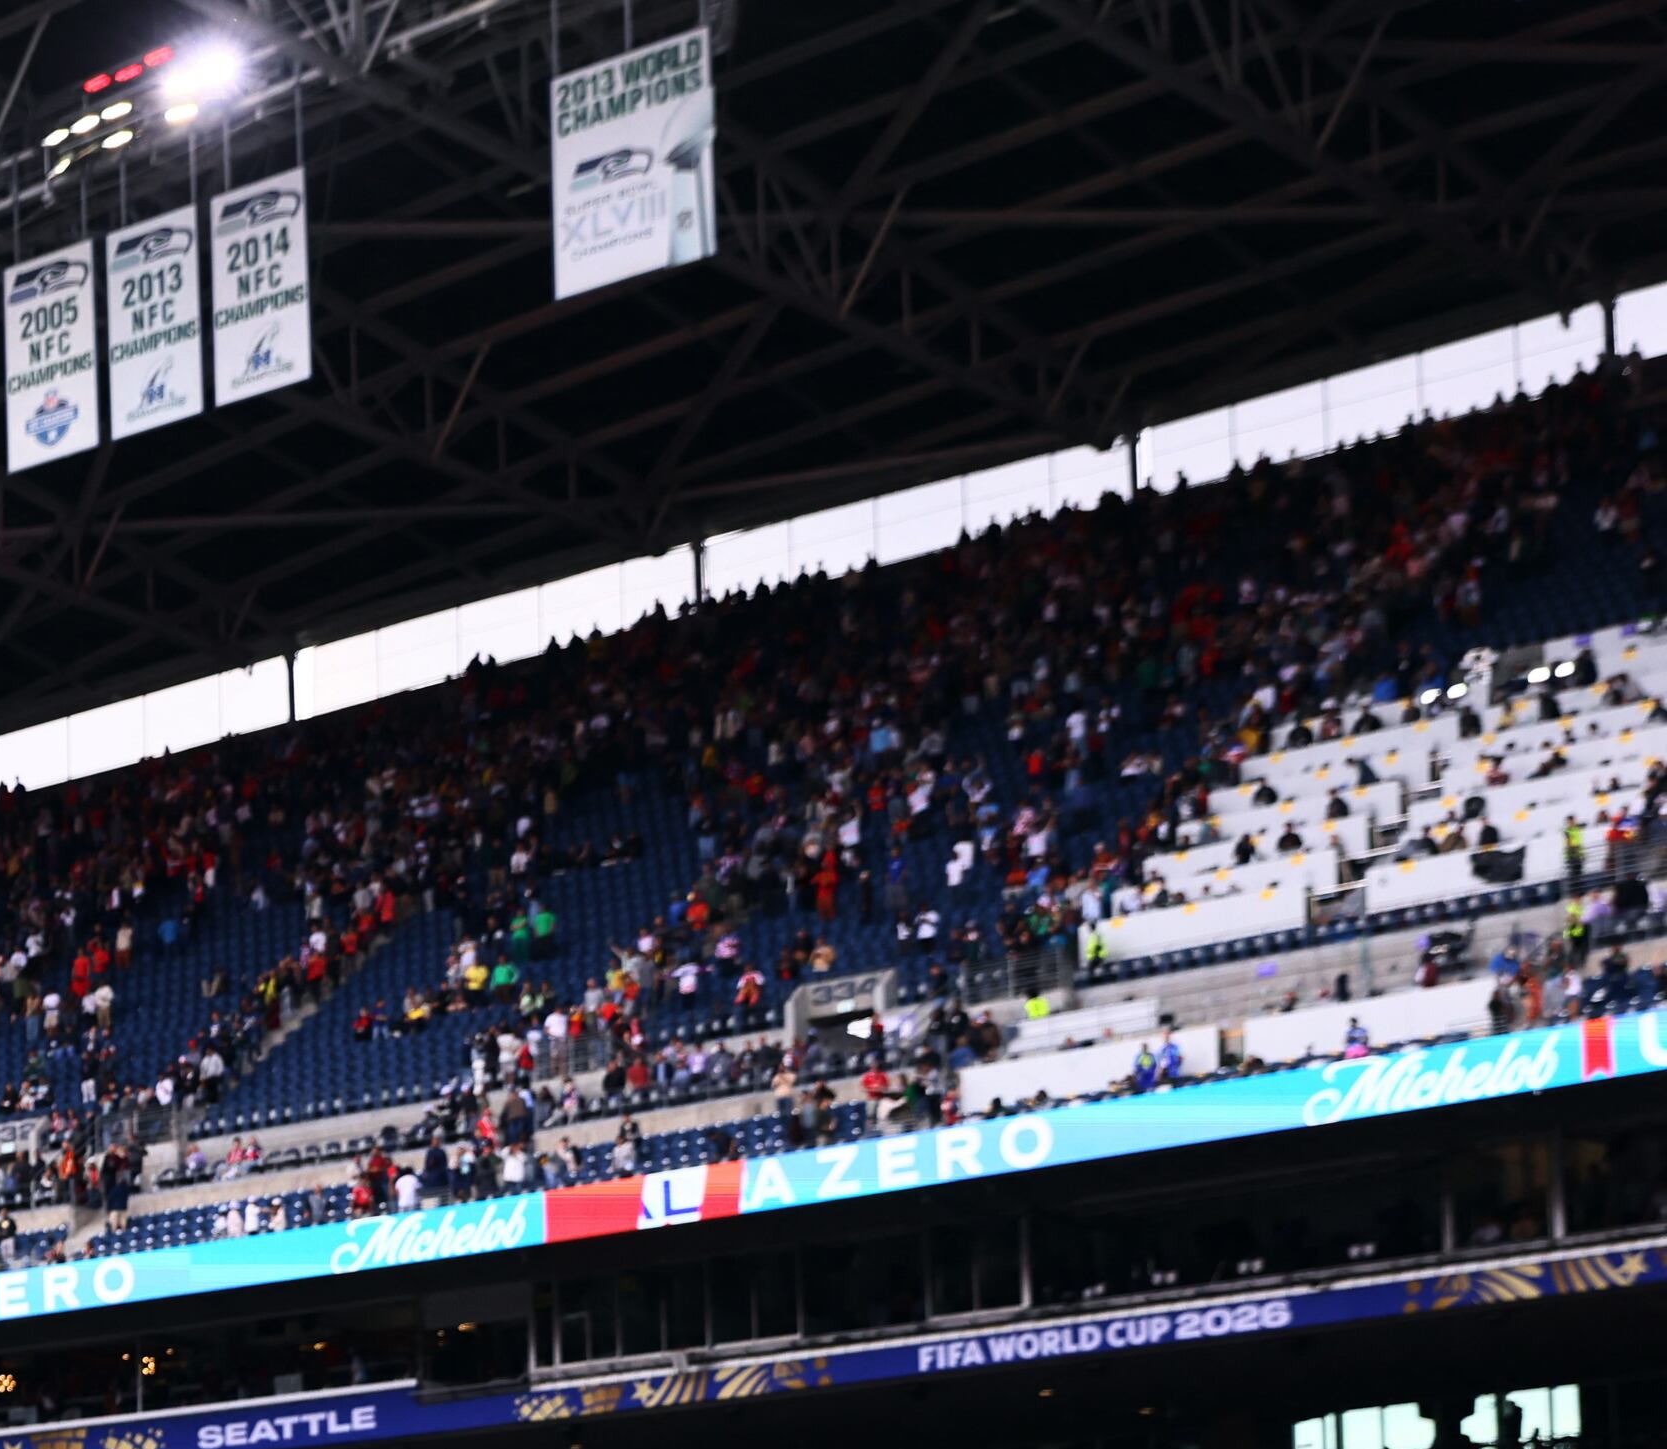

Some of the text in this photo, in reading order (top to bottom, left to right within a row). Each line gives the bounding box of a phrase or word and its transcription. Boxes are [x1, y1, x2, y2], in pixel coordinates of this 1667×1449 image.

[557, 37, 702, 111] 2013 WORLD
[558, 66, 702, 138] CHAMPIONS
[227, 226, 290, 273] 2014
[122, 263, 182, 309] 2013
[237, 263, 282, 298] NFC
[20, 295, 79, 341] 2005
[132, 300, 174, 333] NFC
[216, 285, 305, 330] CHAMPIONS
[29, 331, 71, 365] NFC
[110, 319, 196, 364] CHAMPIONS
[7, 352, 91, 395] CHAMPIONS
[1303, 1030, 1559, 1127] Michelob
[330, 1198, 527, 1275] Michelob
[817, 1115, 1054, 1196] ZERO
[918, 1302, 1292, 1373] FIFA WORLD CUP 2026
[197, 1406, 376, 1449] SEATTLE
